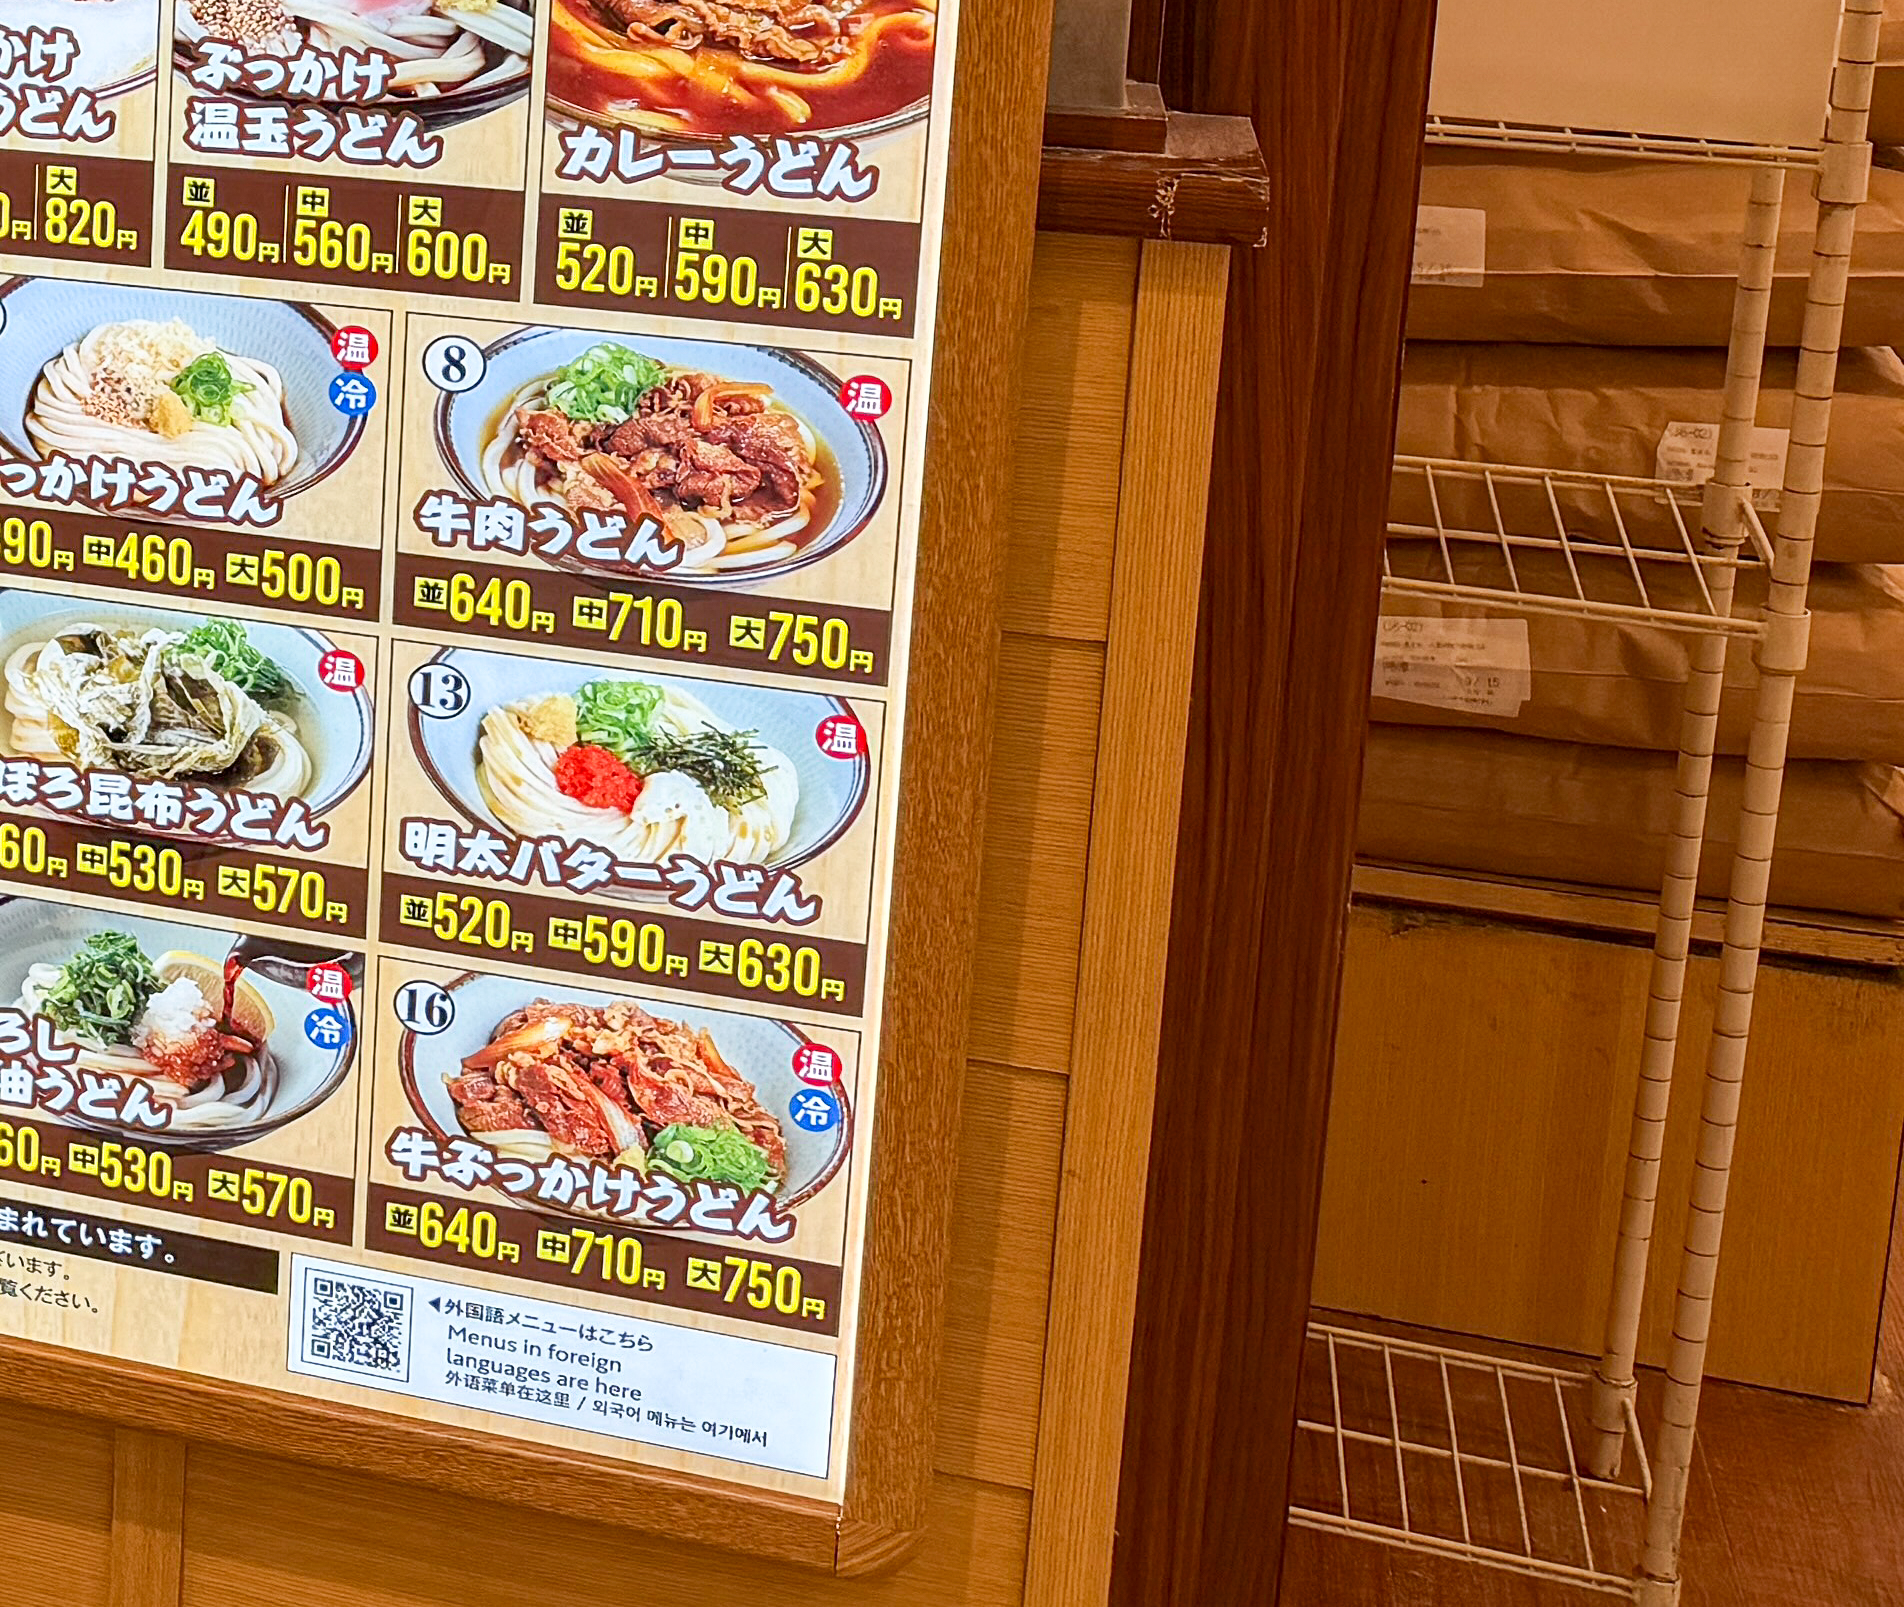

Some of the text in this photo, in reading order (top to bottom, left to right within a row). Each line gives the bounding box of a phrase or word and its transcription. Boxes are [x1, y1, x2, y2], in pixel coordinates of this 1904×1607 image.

[194, 47, 391, 102] ぶっかけ
[192, 102, 440, 168] 温玉うどん
[560, 125, 878, 197] カレーうどん
[420, 495, 681, 566] 牛肉うどん
[405, 823, 816, 920] 明太バターうどん
[389, 1134, 792, 1239] 牛ぶっかけうどん
[444, 1298, 654, 1352] 外国語メニューはこちら
[448, 1325, 622, 1374] Menus in foreign
[447, 1348, 642, 1401] languages are here
[593, 1400, 768, 1447] 외국어 메뉴는 여기에서
